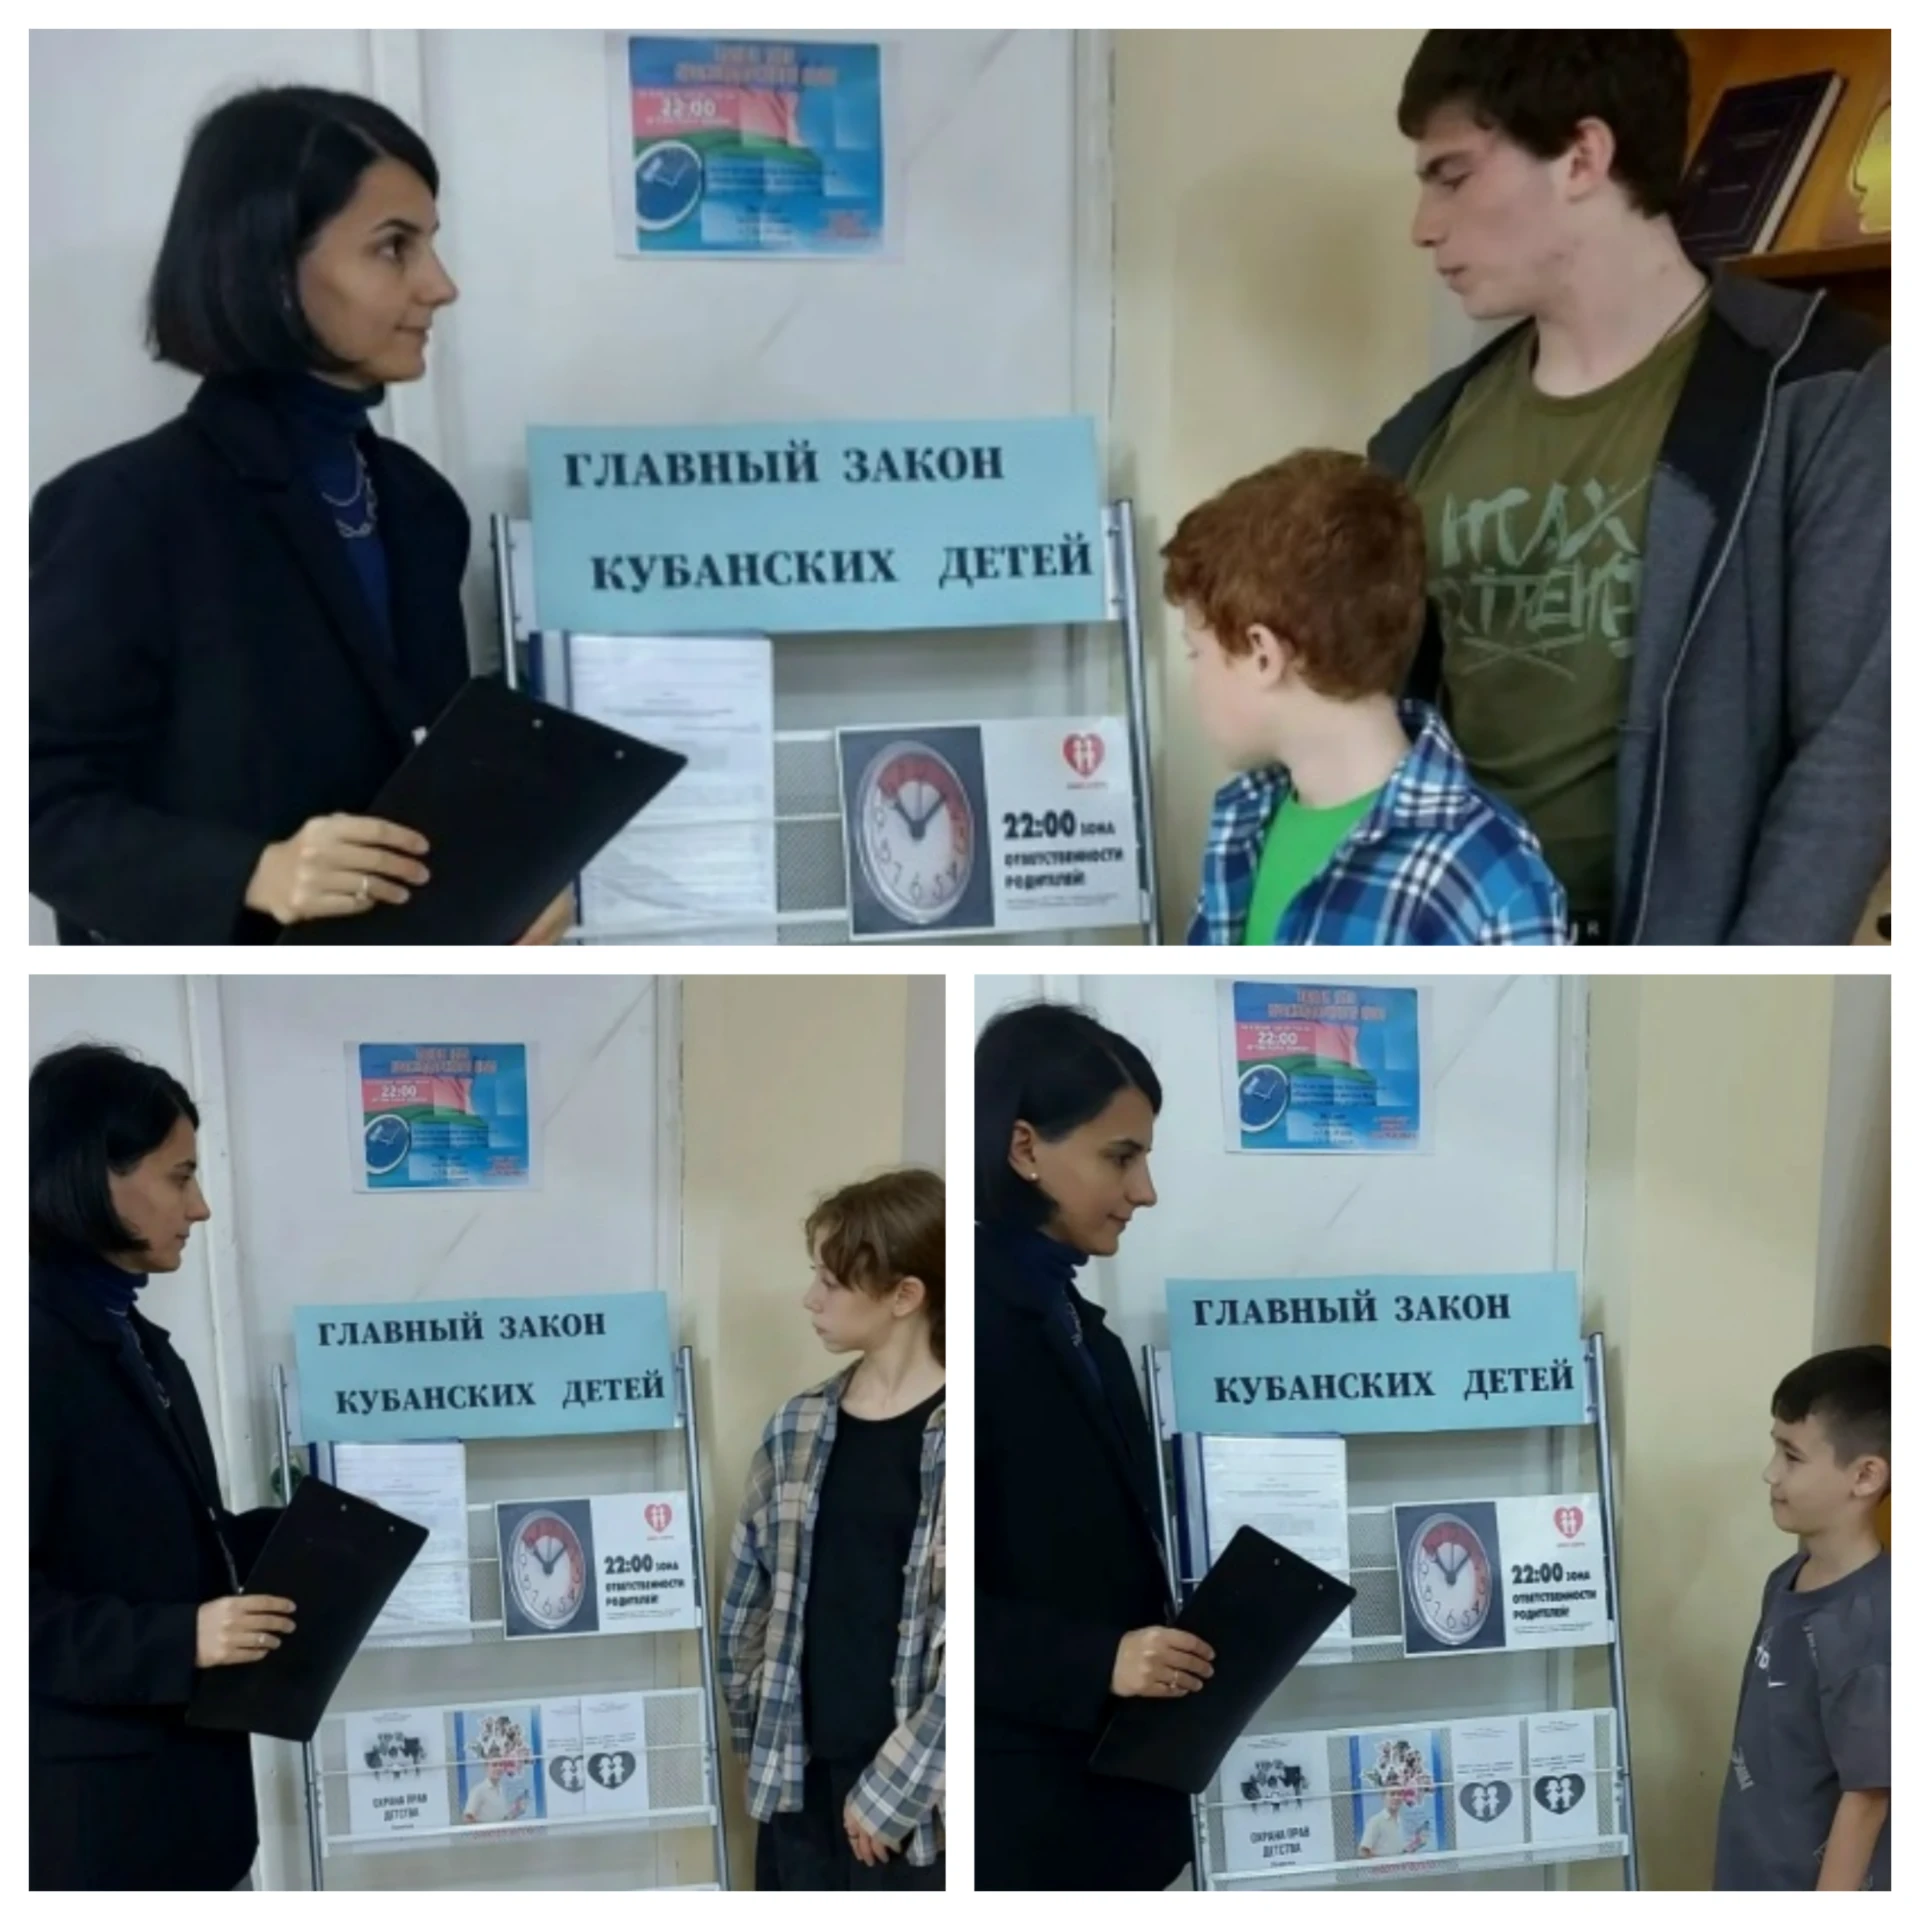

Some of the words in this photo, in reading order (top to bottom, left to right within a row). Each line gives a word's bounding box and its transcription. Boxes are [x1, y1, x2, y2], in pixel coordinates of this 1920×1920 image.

[564, 440, 820, 489] ГЛАВНЫЙ
[843, 446, 1005, 485] ЗАКОН
[590, 547, 899, 593] КУБАНСКИХ
[938, 532, 1094, 589] ДЕТЕЙ
[1002, 808, 1076, 839] 22:00
[1080, 821, 1116, 836] ЗОНА
[1003, 847, 1124, 867] ОТВЕТСТВЕННОСТИ
[1193, 1289, 1379, 1327] ГЛАВНЫЙ
[1394, 1293, 1511, 1322] ЗАКОН
[318, 1310, 485, 1347] ГЛАВНЫЙ
[499, 1312, 606, 1340] ЗАКОН
[335, 1382, 537, 1416] КУБАНСКИХ
[562, 1369, 665, 1409] ДЕТЕЙ
[1214, 1370, 1436, 1406] КУБАНСКИХ
[1463, 1358, 1575, 1401] ДЕТЕЙ
[603, 1553, 653, 1575] 22:00
[655, 1562, 679, 1572] ЗОНА
[1511, 1561, 1563, 1585] 22:00
[1566, 1570, 1591, 1582] ЗОНА
[605, 1577, 686, 1593] ОТВЕТСТВЕННОСТИ
[1512, 1589, 1597, 1605] ОТВЕТСТВЕННОСТИ
